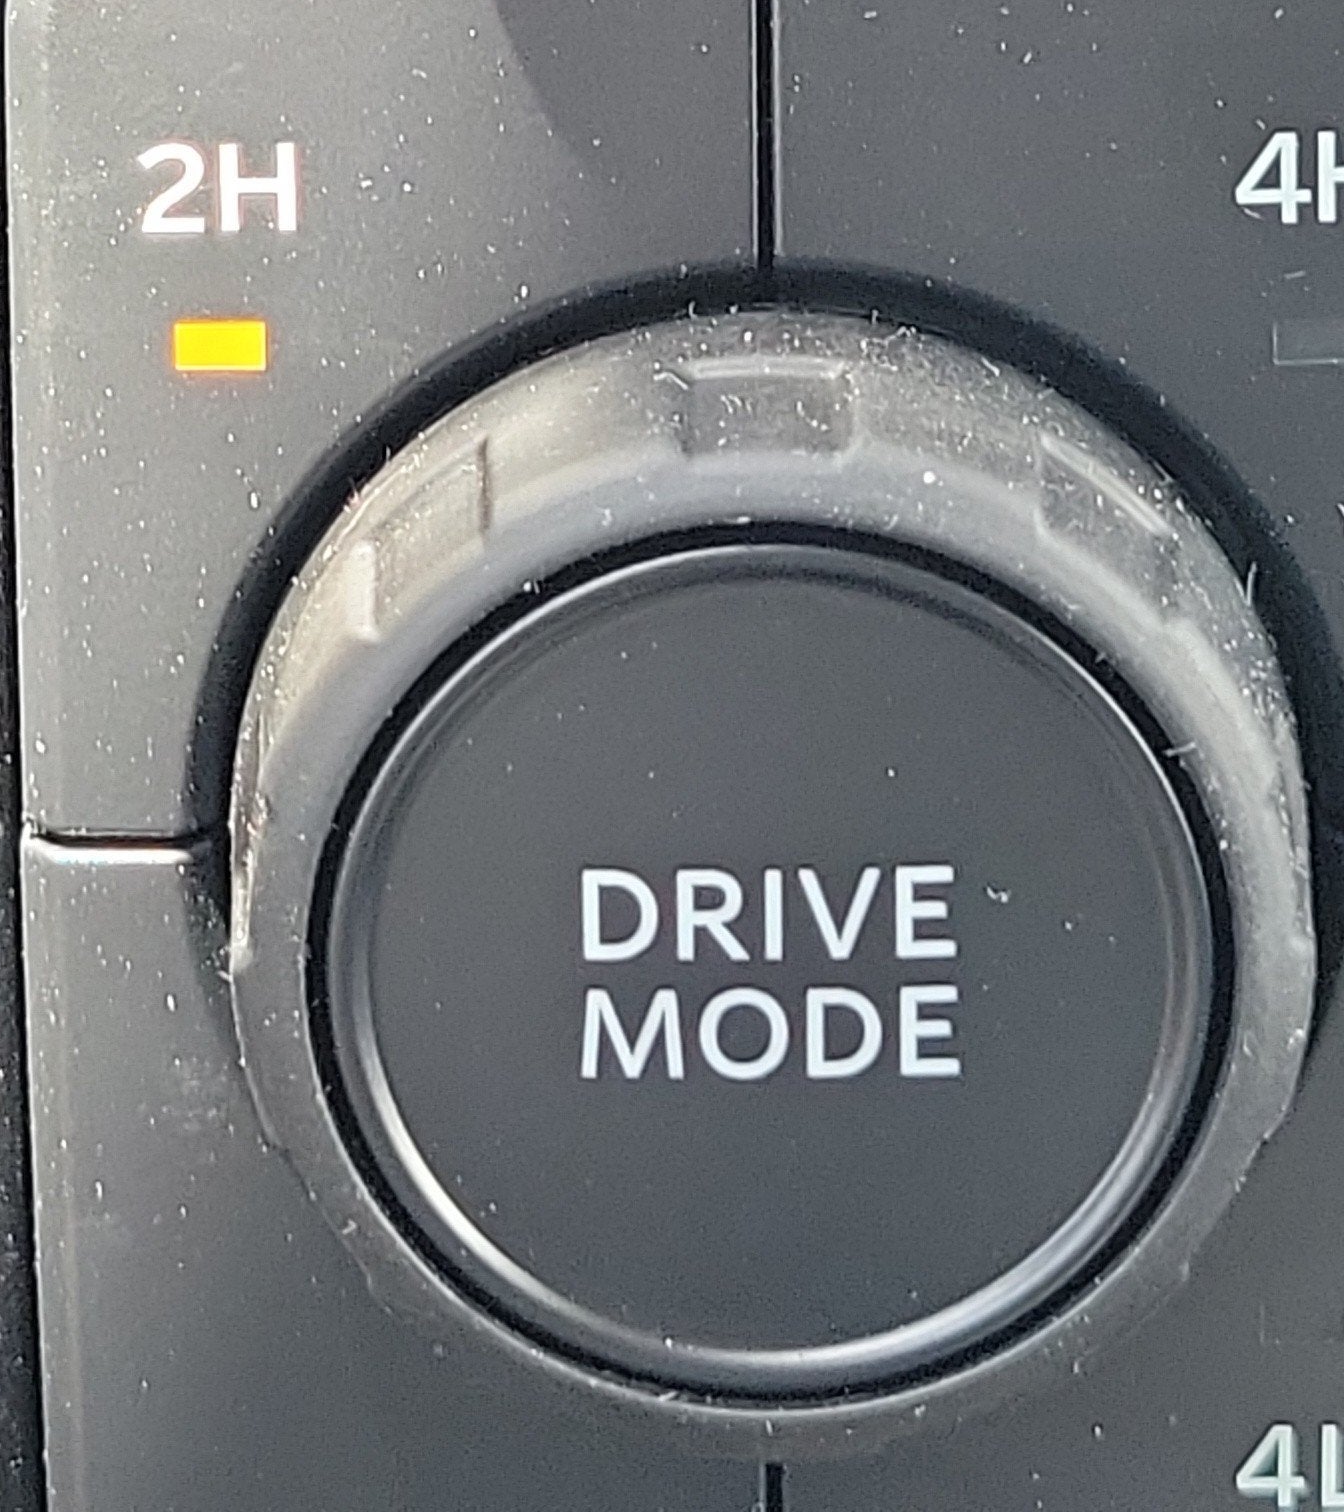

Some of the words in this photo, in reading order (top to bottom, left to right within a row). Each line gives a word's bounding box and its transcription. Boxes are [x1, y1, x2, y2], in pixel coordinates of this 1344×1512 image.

[136, 141, 299, 234] 2H
[580, 864, 958, 963] DRIVE
[579, 984, 962, 1081] MODE
